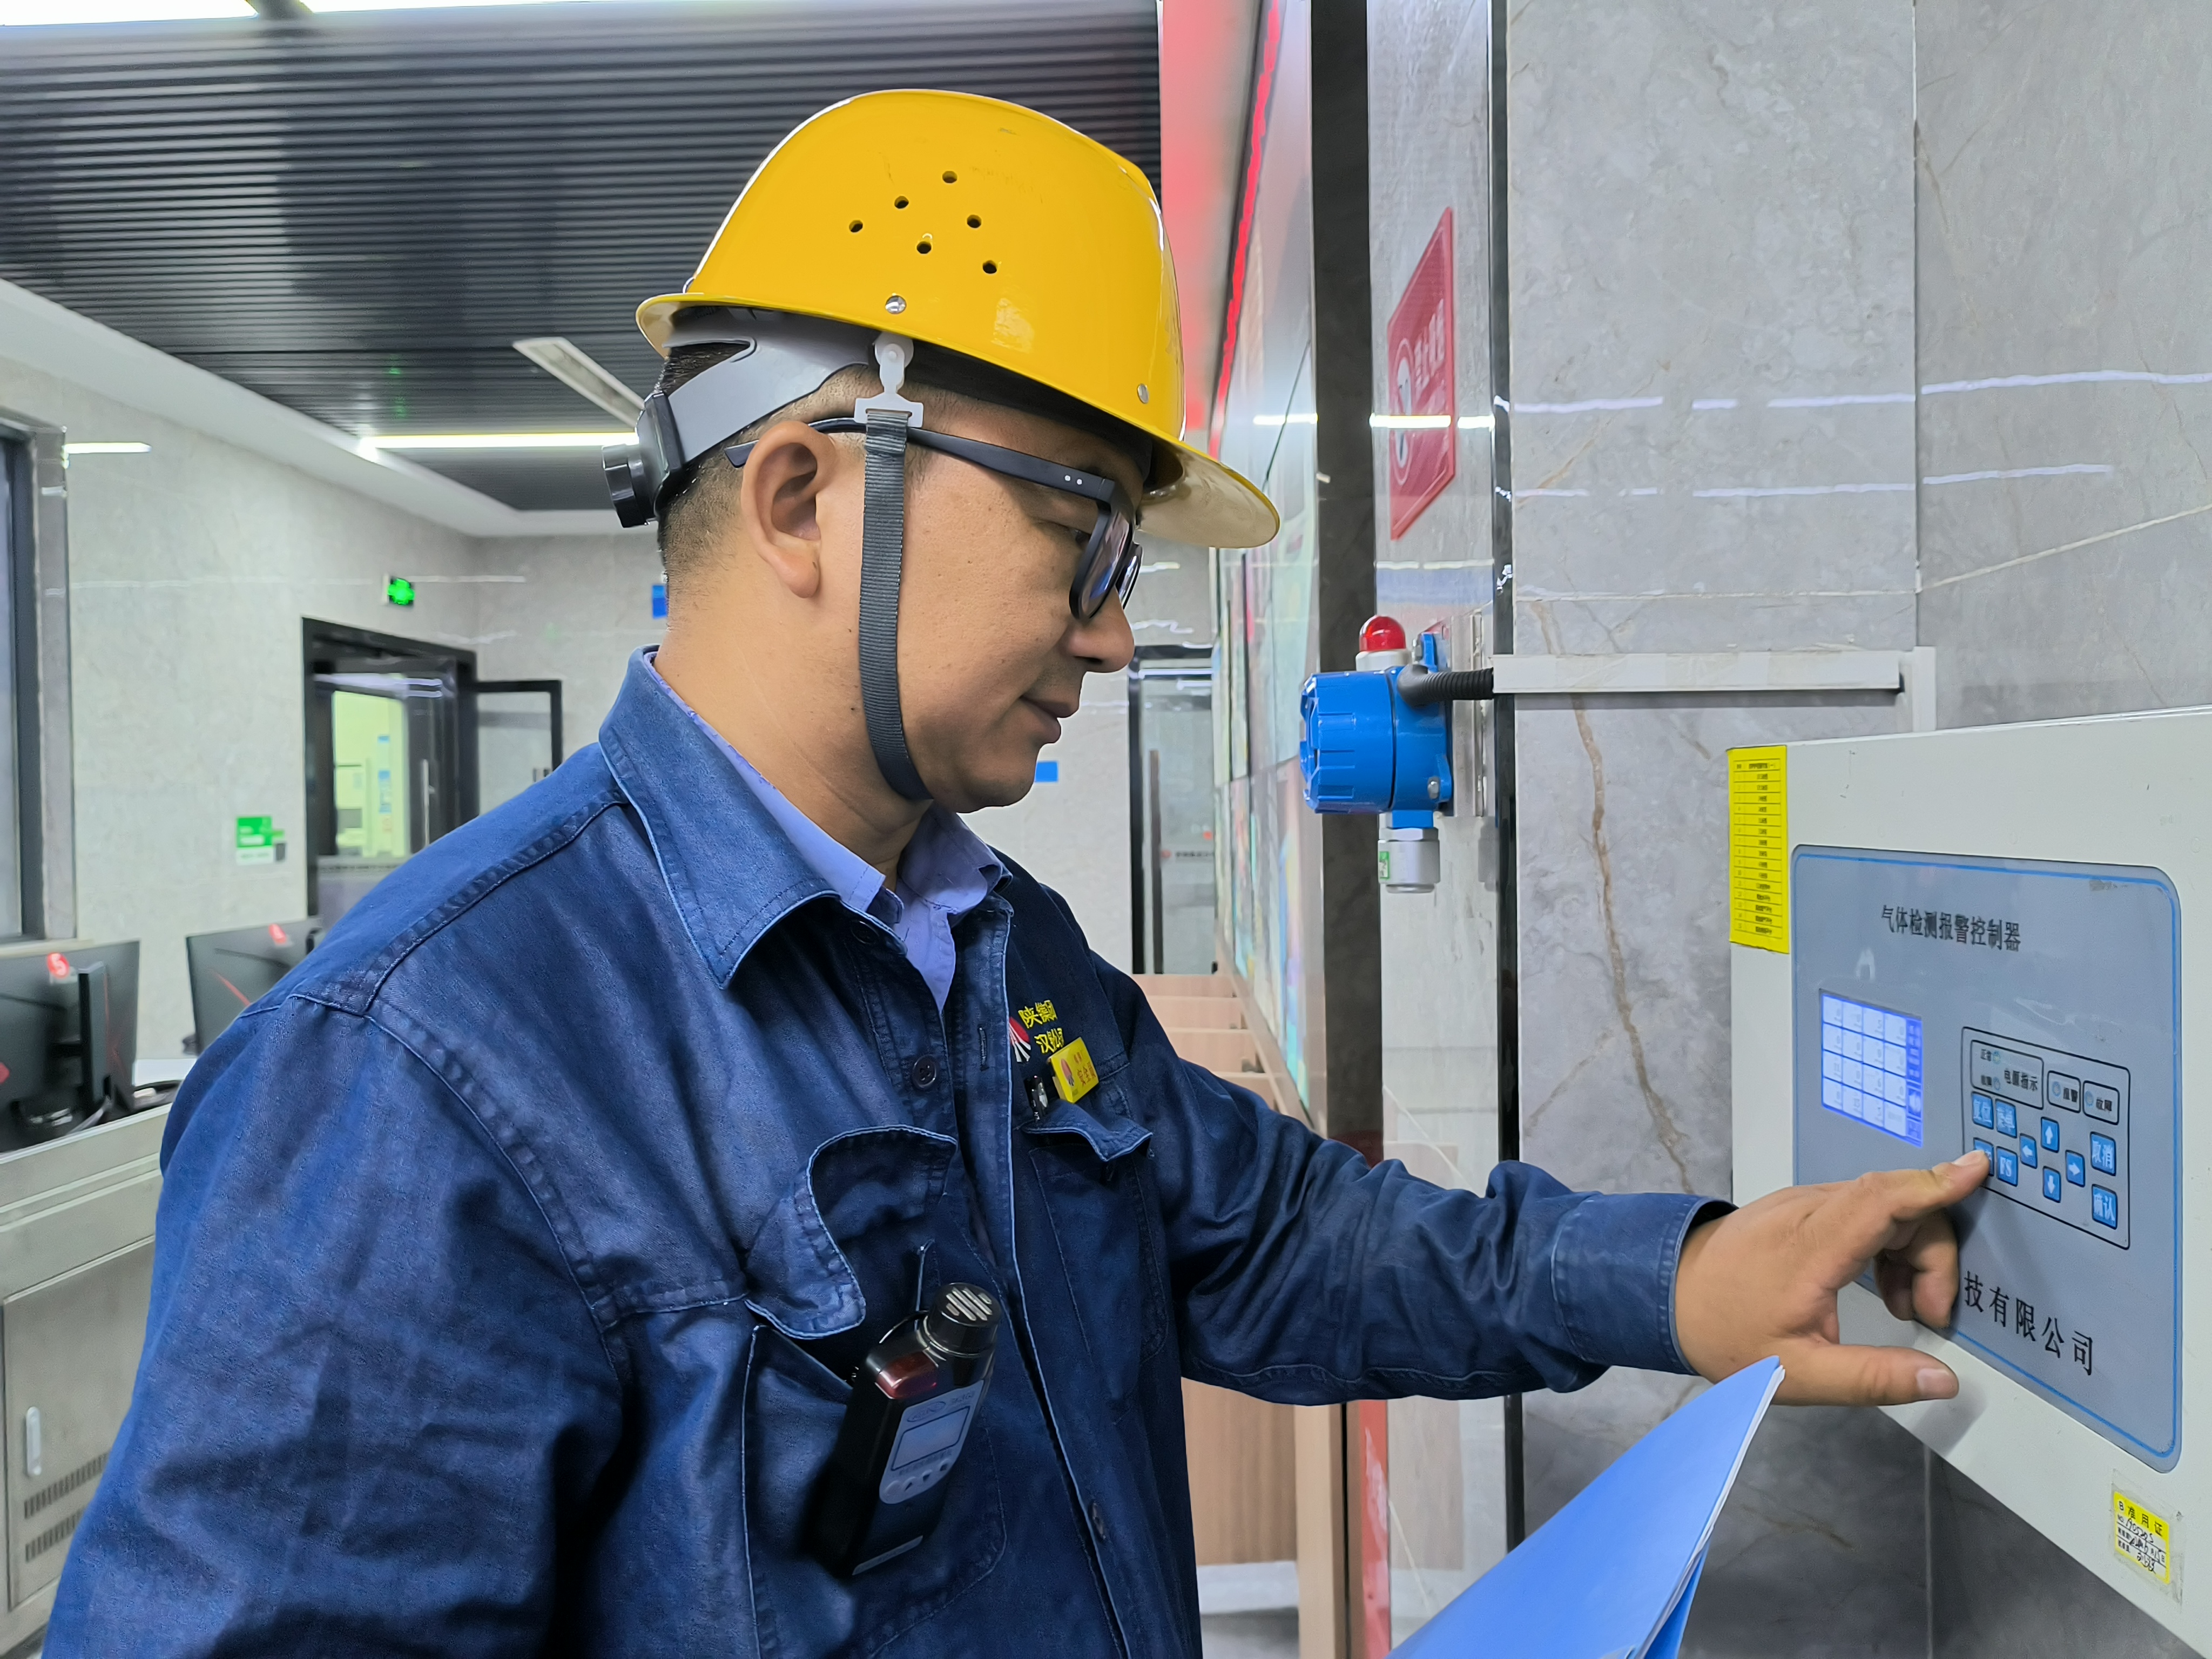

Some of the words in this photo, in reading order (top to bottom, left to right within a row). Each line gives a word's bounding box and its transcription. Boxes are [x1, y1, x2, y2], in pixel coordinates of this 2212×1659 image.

[1881, 905, 2021, 952] 气体检测报警控制器
